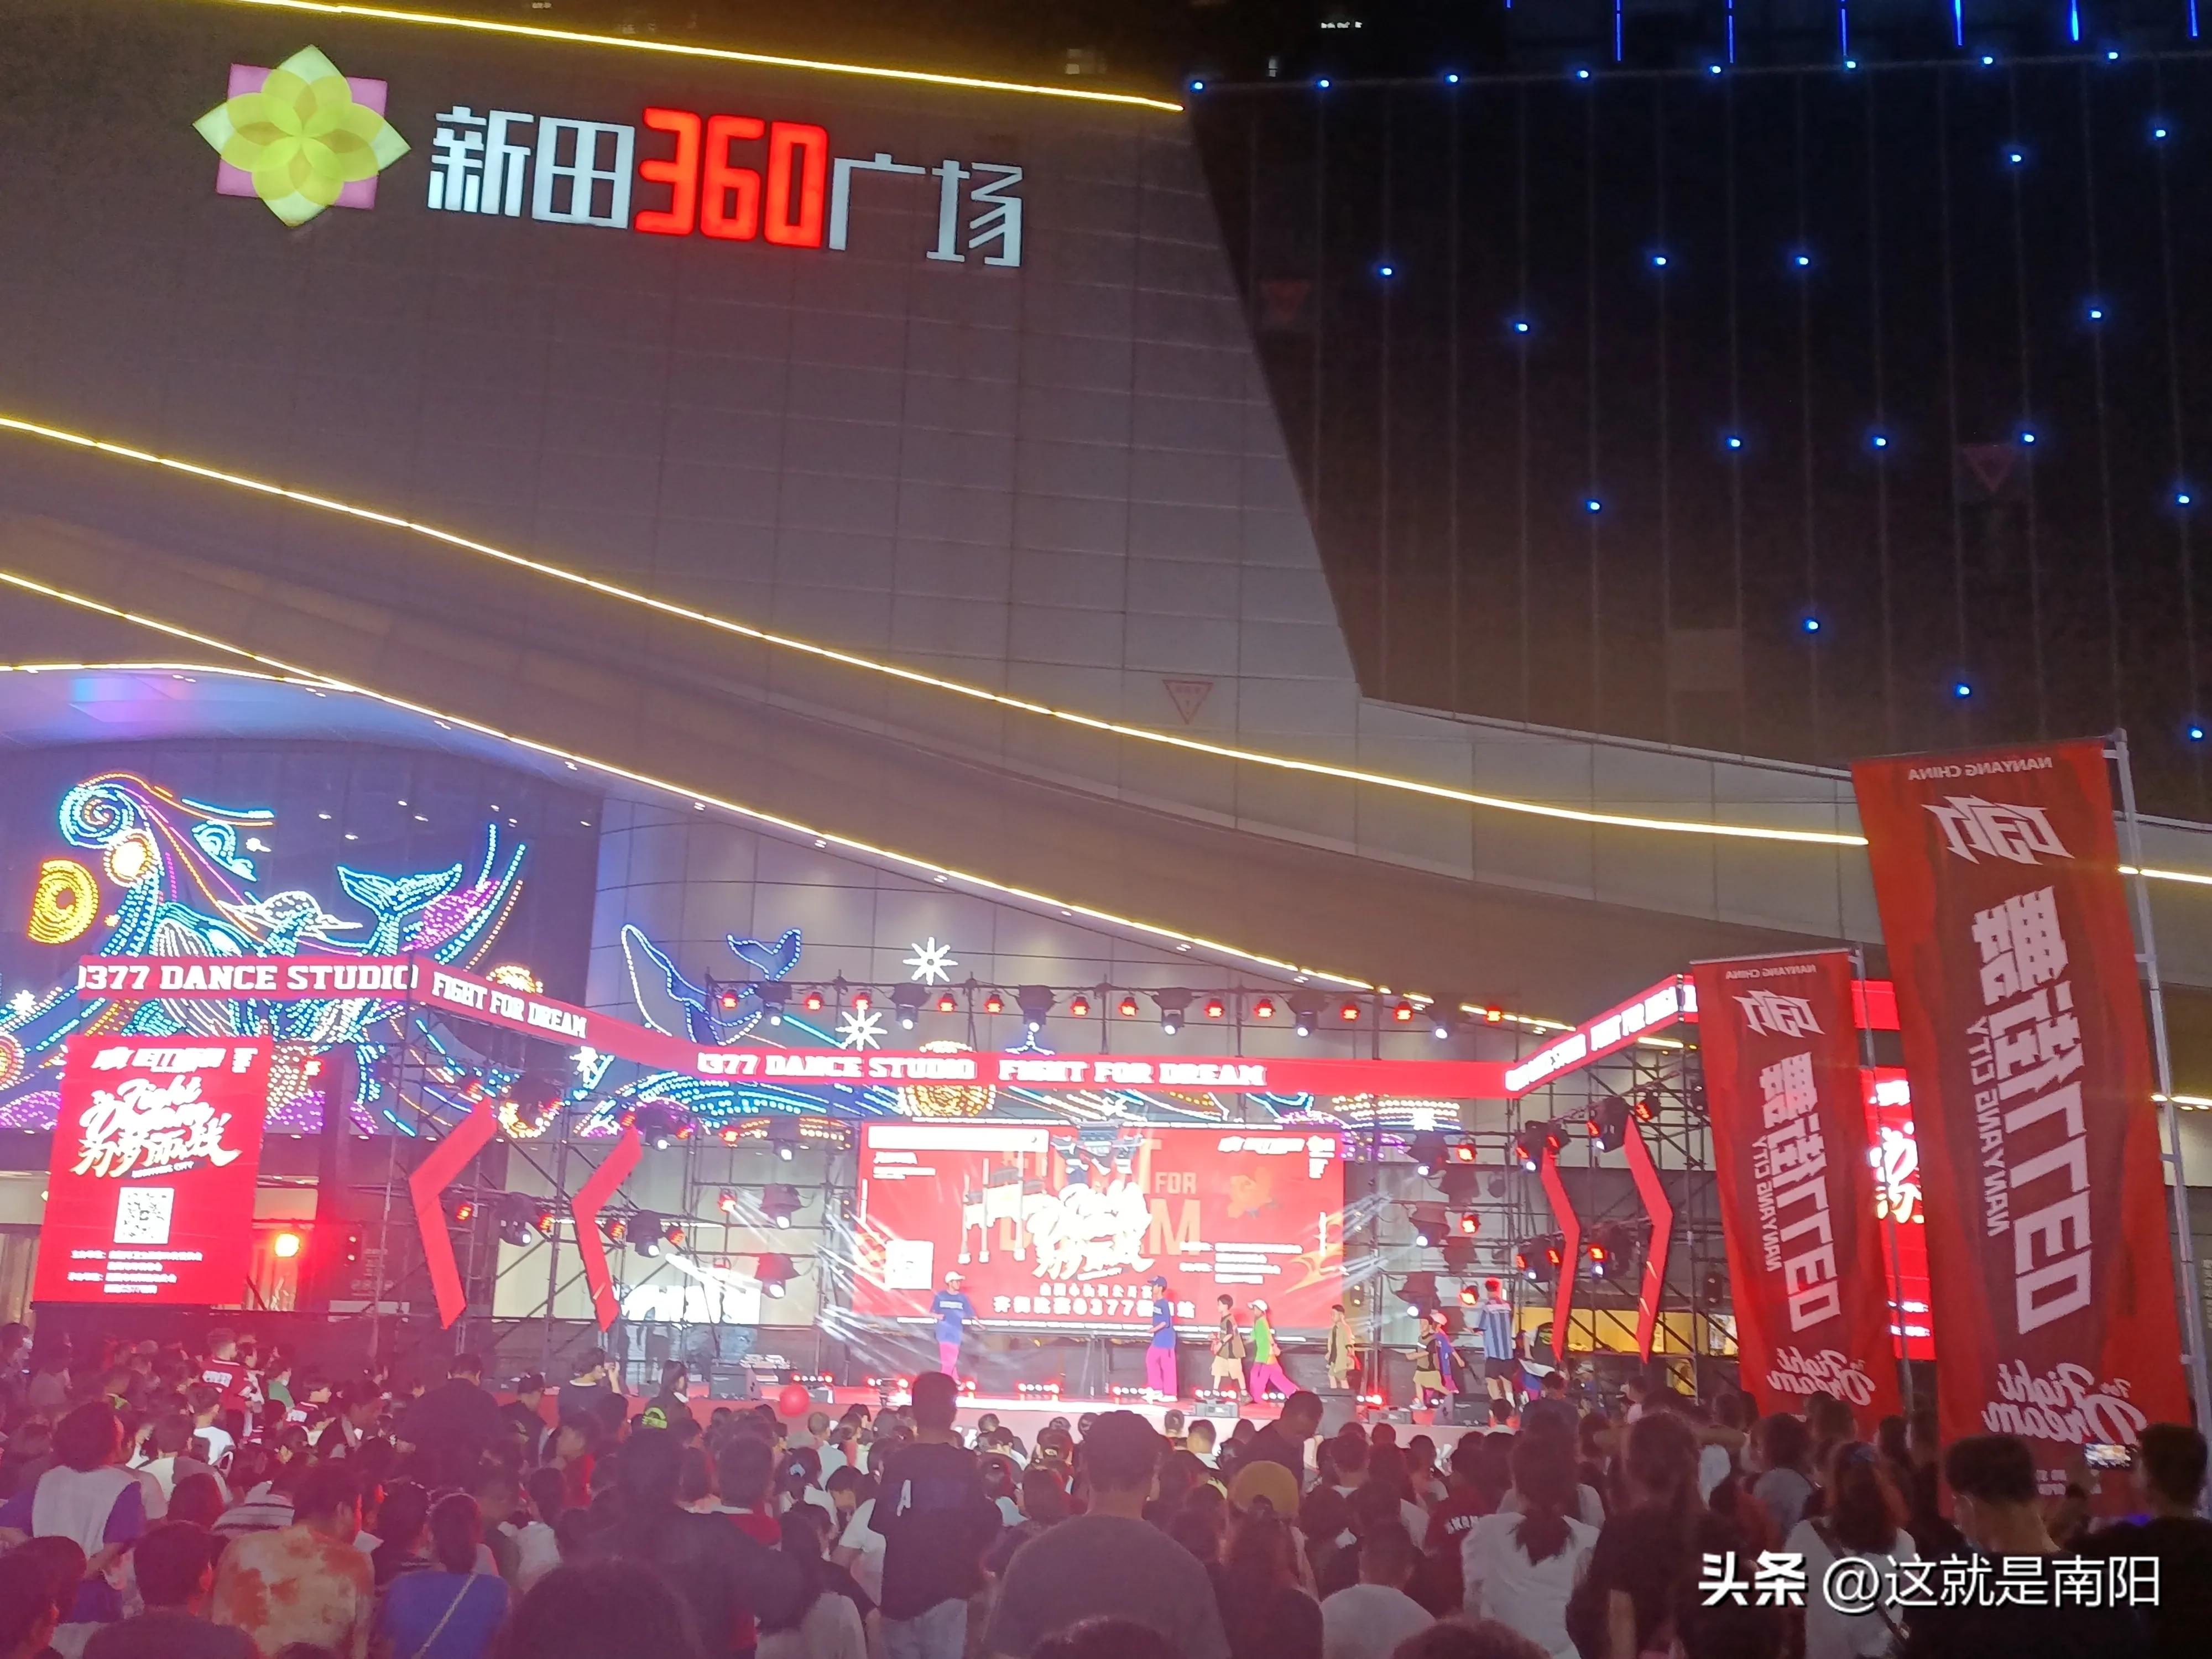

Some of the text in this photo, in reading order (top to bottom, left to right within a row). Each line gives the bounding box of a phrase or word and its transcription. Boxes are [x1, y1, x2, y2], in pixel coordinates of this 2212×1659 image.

[427, 102, 1024, 268] 新田360广场
[159, 965, 278, 990] DANCE
[286, 964, 419, 990] STUDIO
[432, 971, 587, 1039] FIGHT FOR DREAM
[765, 1055, 864, 1077] DANCE
[869, 1056, 977, 1079] STUDIO
[1094, 1061, 1154, 1084] FOR
[1159, 1063, 1267, 1086] DREAM
[1155, 1172, 1197, 1194] FOR
